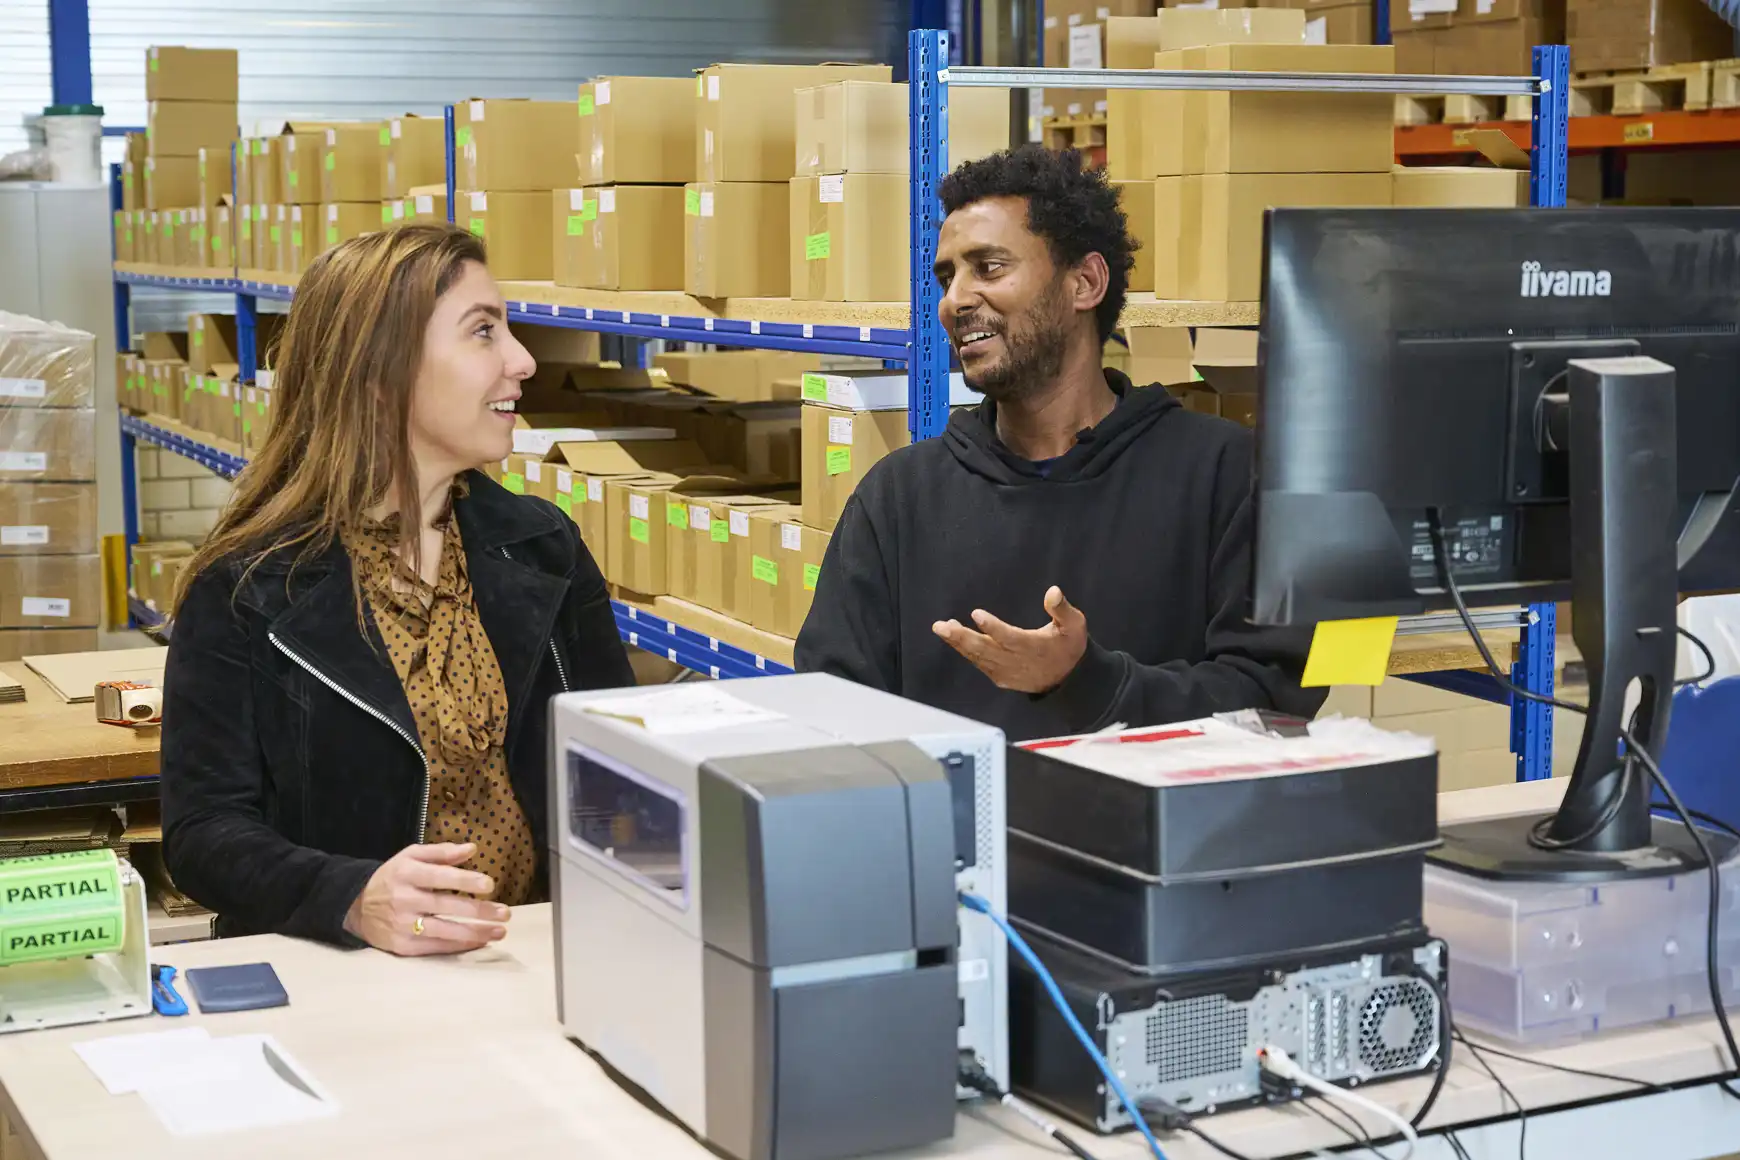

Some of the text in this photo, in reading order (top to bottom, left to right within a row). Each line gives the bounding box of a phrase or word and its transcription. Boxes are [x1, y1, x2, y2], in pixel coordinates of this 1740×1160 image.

[1521, 260, 1612, 297] iiyama
[6, 878, 107, 903] PARTIAL
[10, 926, 110, 950] PARTIAL
